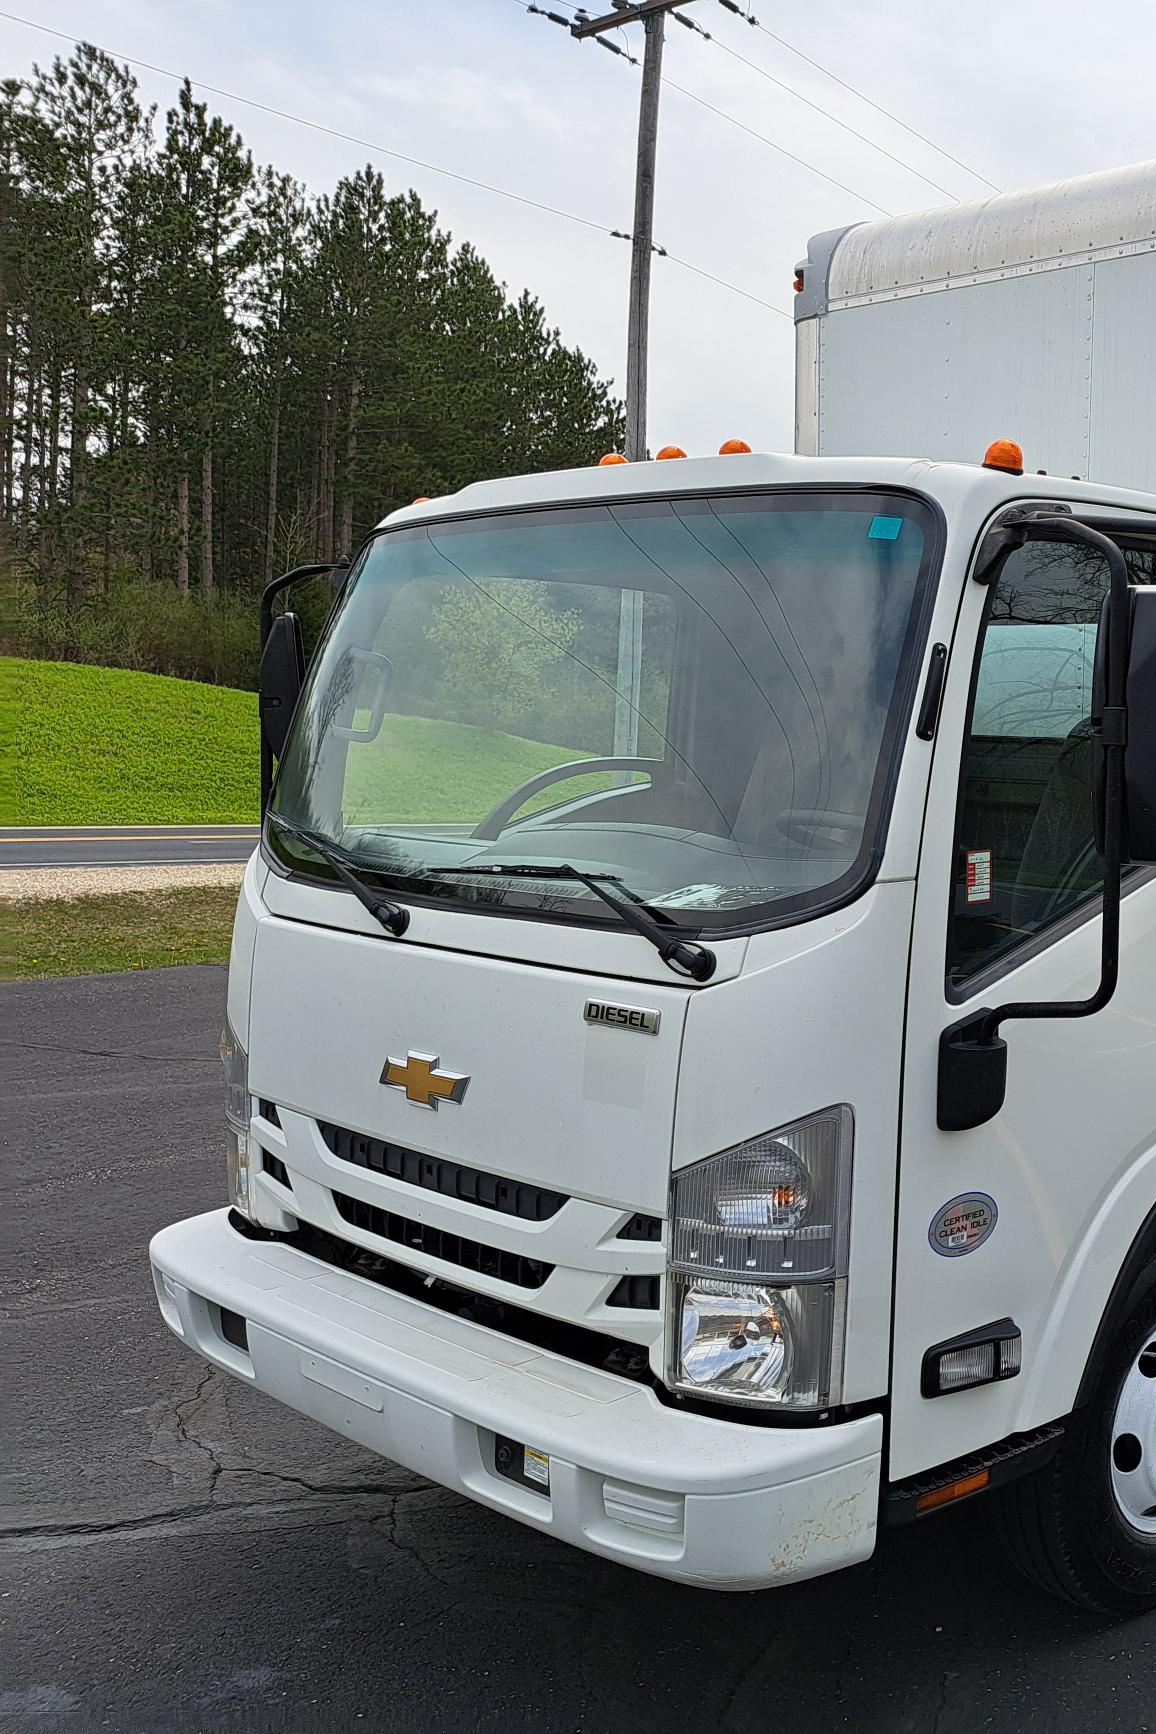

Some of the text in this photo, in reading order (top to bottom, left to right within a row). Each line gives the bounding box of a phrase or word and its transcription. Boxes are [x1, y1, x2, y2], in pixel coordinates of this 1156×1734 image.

[587, 1003, 650, 1029] DIESEL
[939, 1224, 968, 1238] CLEAN
[970, 1217, 989, 1229] IDLE
[943, 1209, 985, 1227] CERTIFIED
